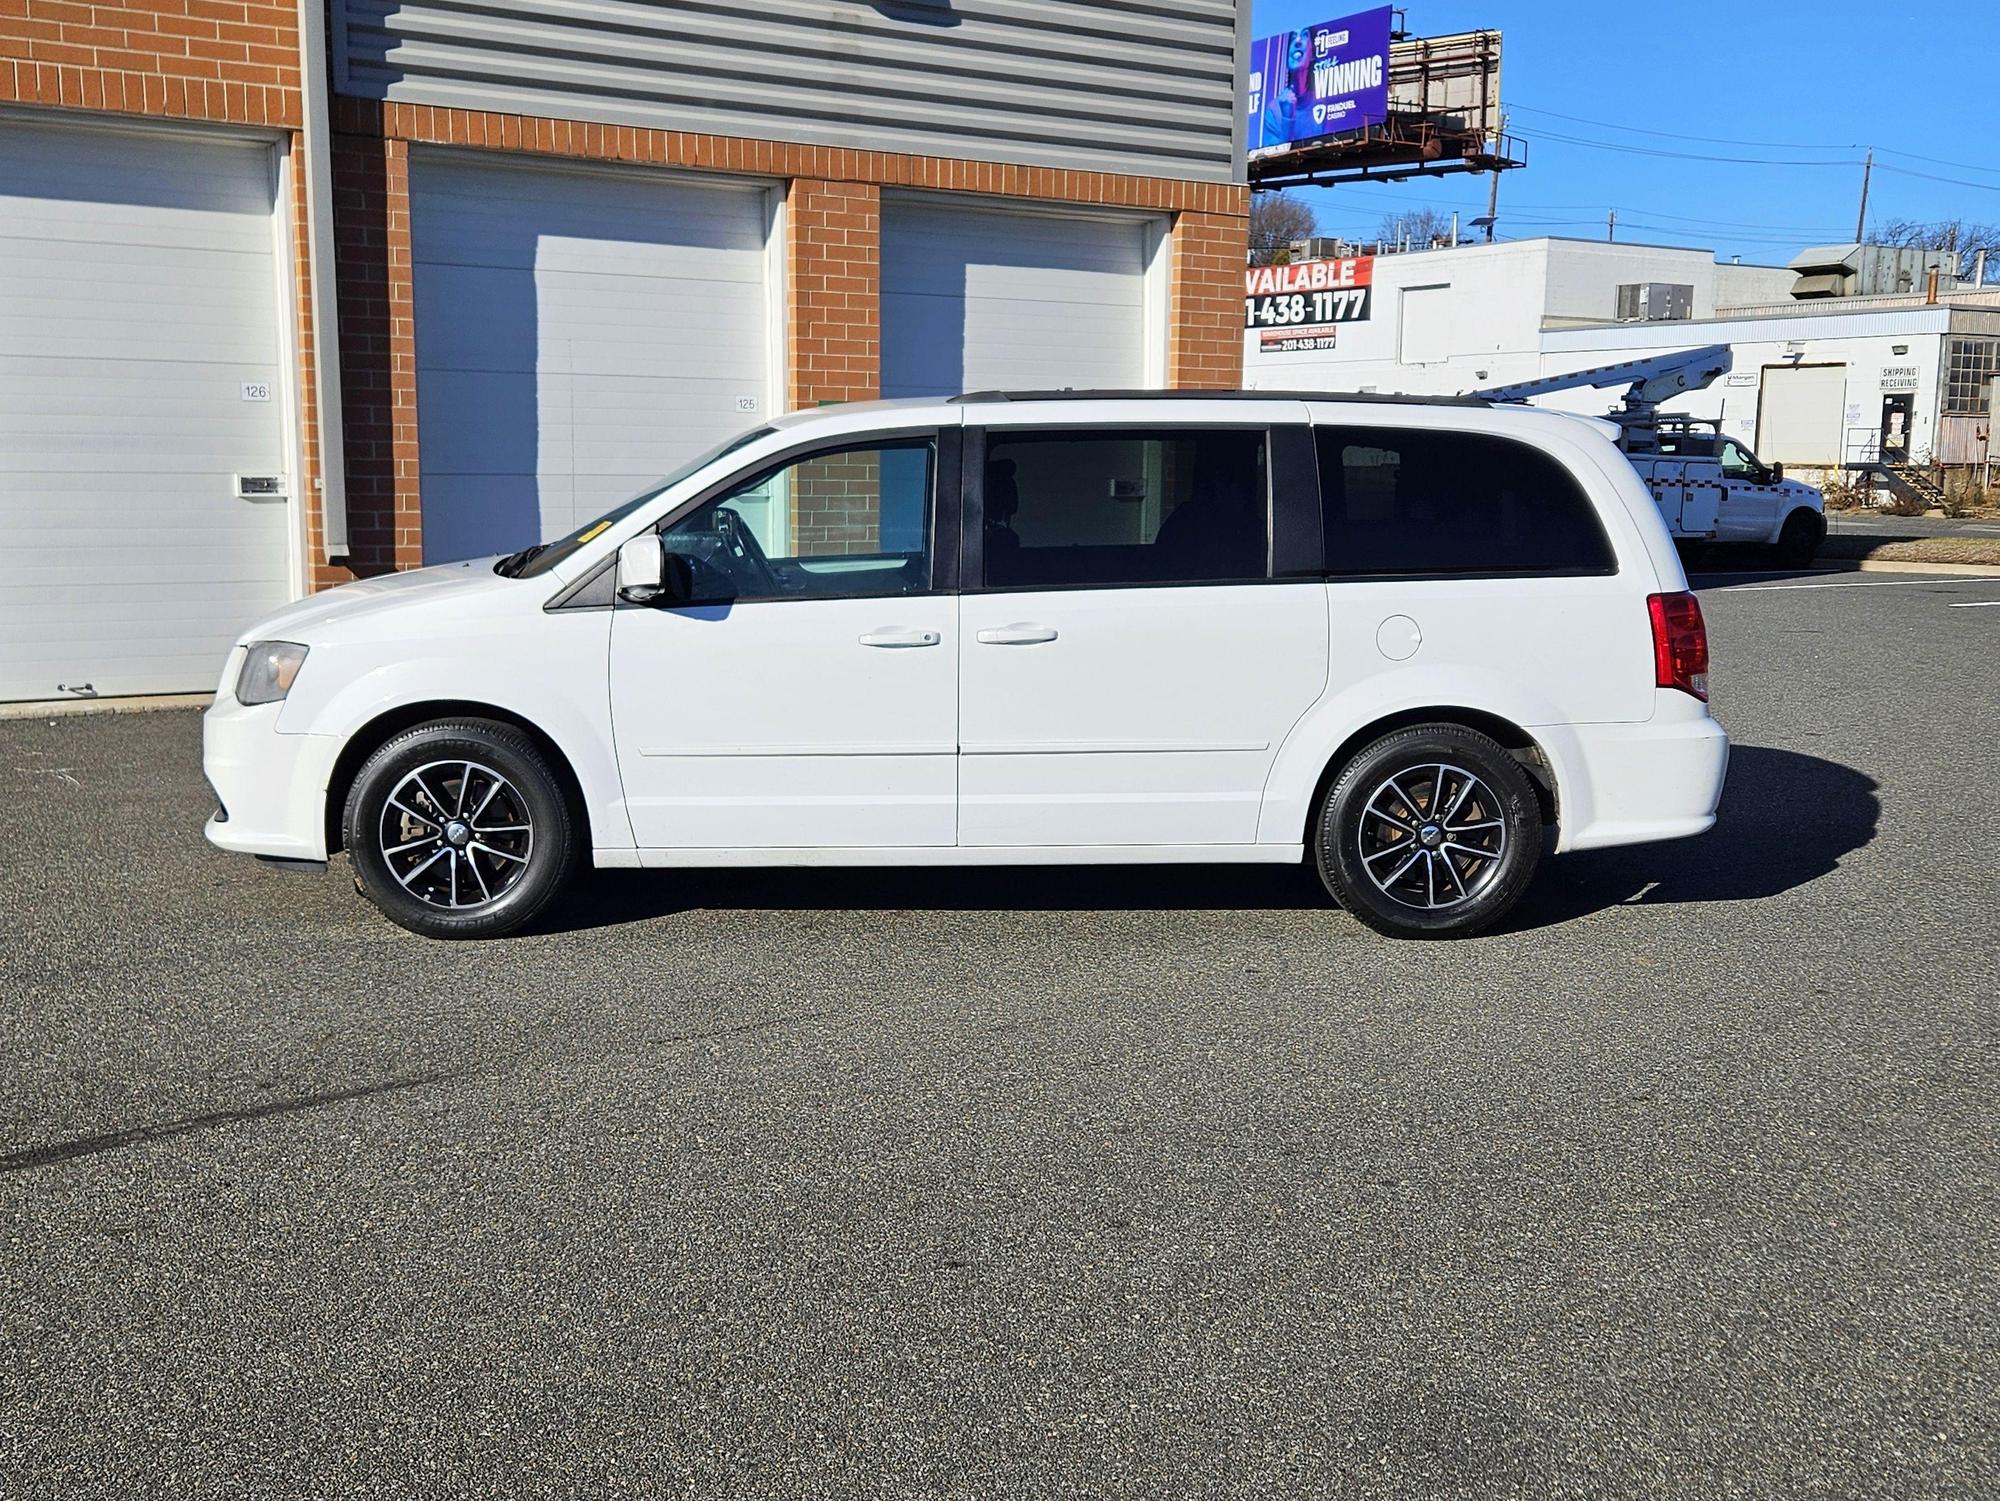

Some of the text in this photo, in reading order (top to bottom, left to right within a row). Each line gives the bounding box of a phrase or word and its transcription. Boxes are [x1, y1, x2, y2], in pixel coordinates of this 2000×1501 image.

[1314, 55, 1382, 99] WINNING
[1327, 100, 1356, 112] FANDUEL
[1282, 337, 1335, 351] 201-438-1177
[1883, 367, 1917, 377] SHIPPING
[1881, 378, 1917, 388] RECEIVING
[246, 385, 267, 398] 126
